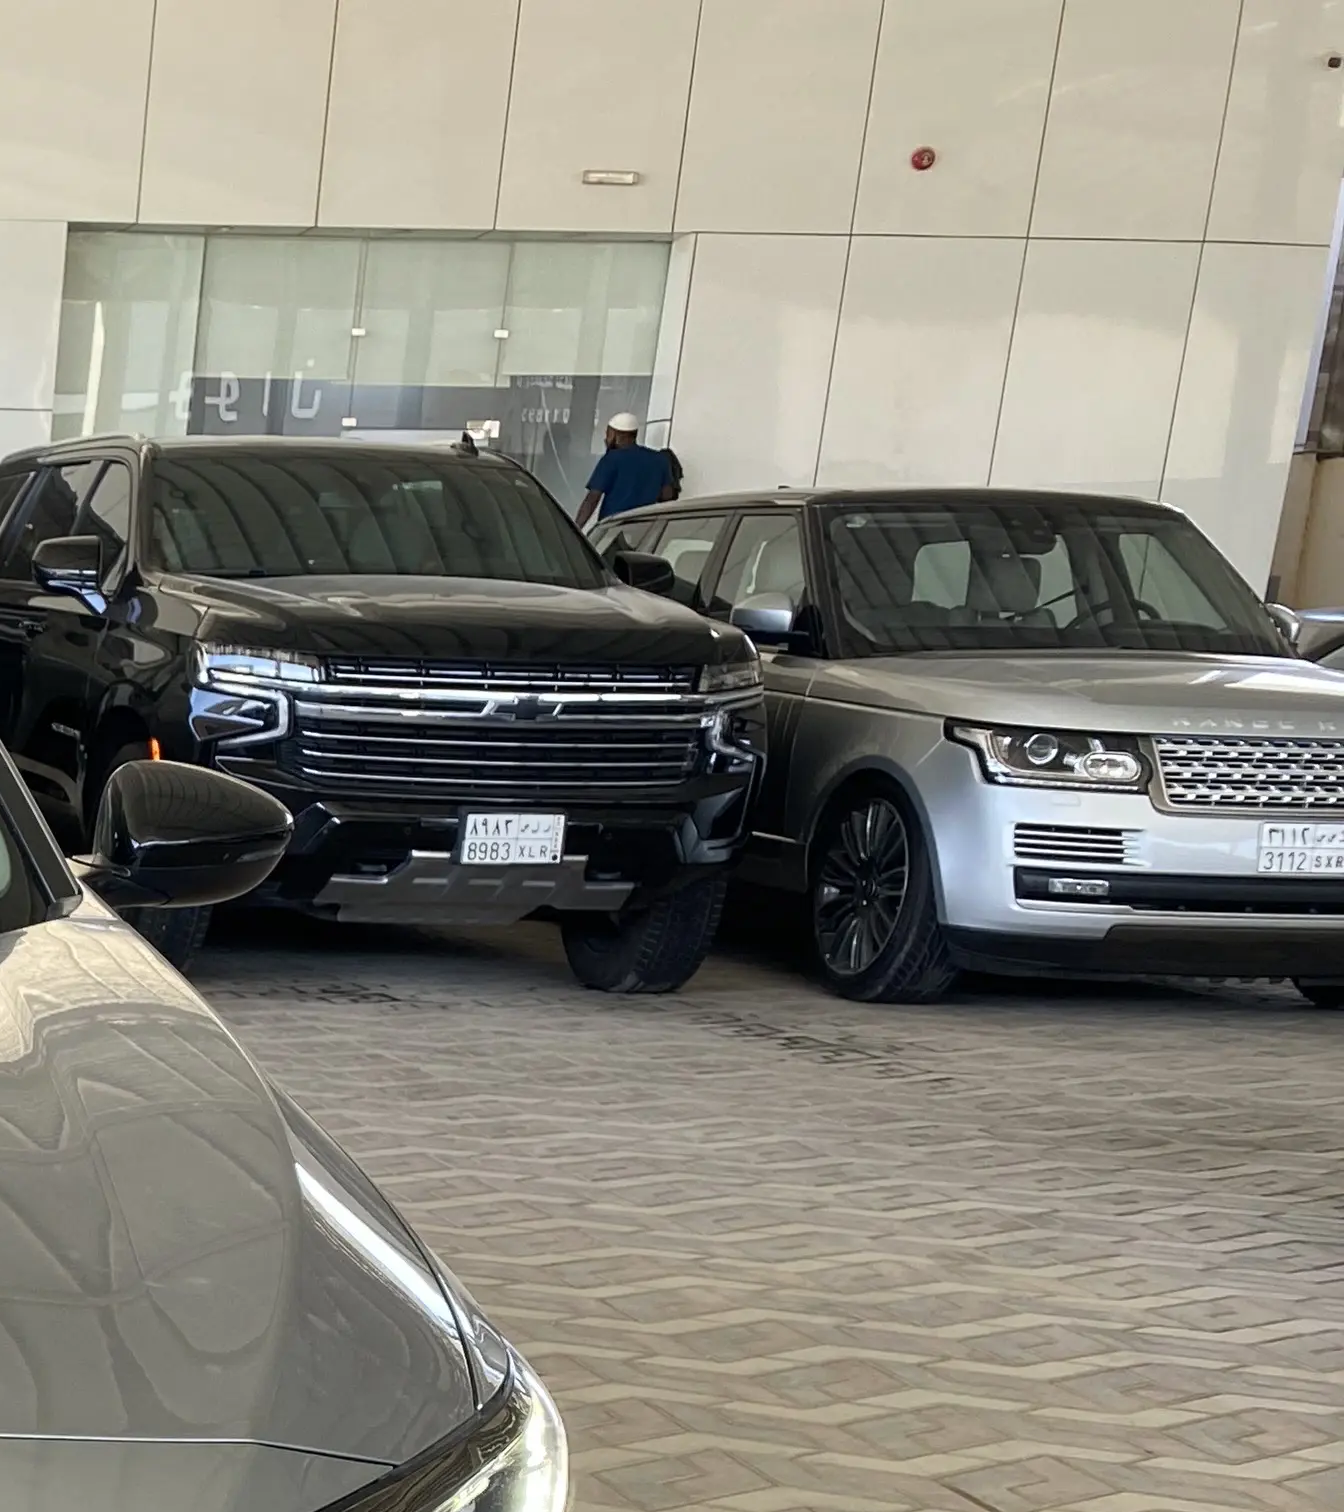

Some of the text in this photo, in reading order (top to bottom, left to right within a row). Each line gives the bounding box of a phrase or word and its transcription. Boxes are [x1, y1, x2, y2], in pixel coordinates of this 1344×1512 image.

[467, 841, 549, 861] 8983 XLR
[1263, 851, 1343, 872] 3112 SXR
